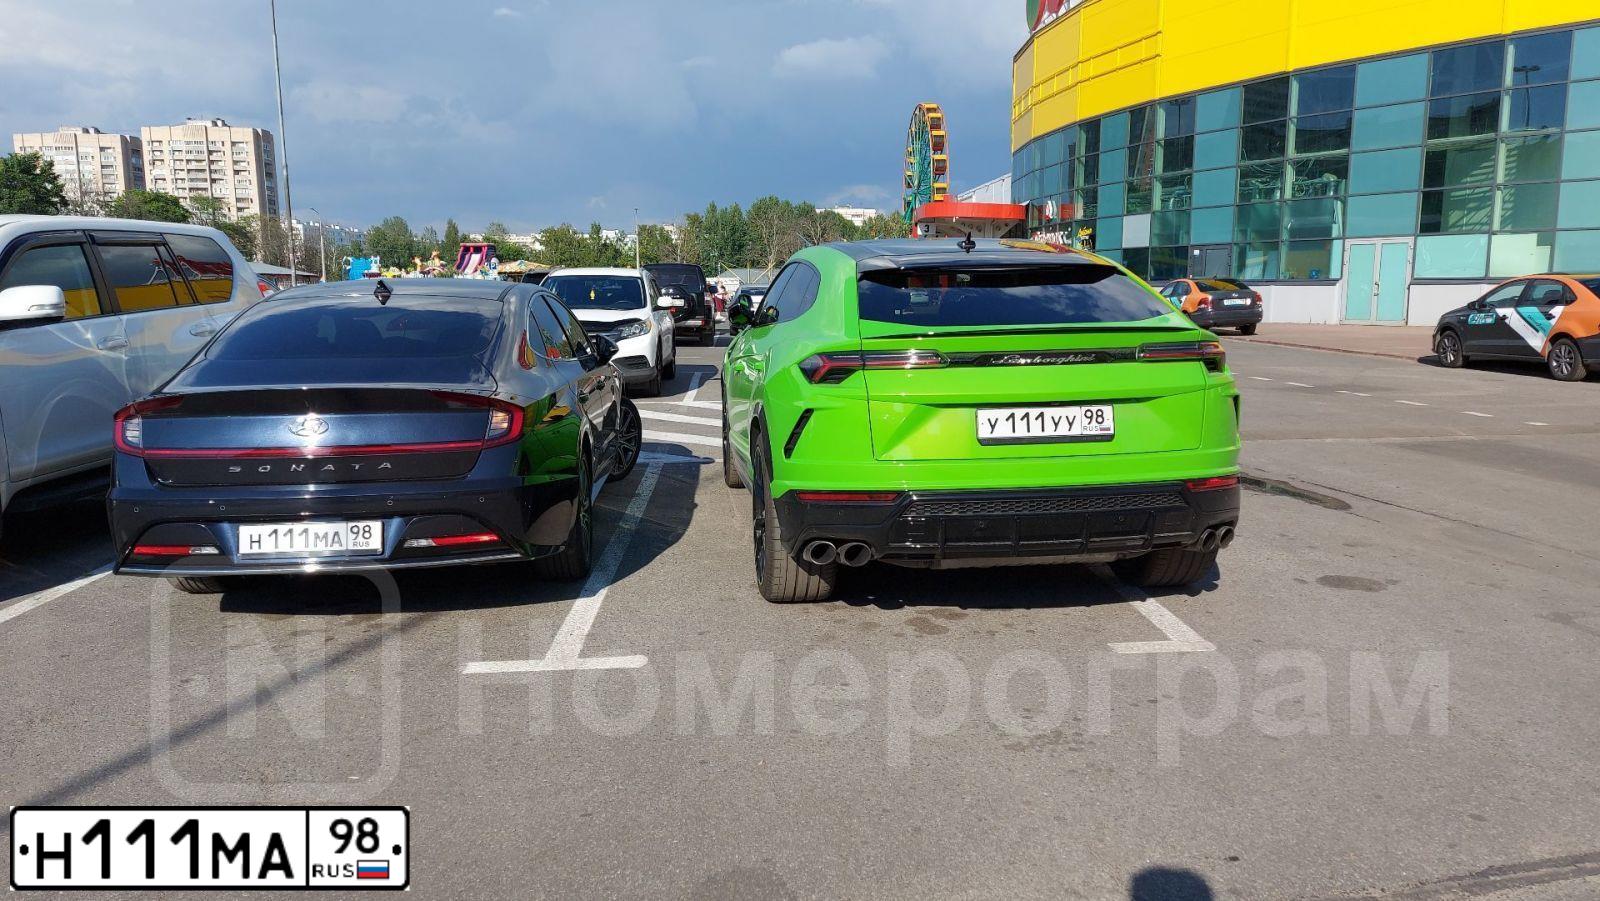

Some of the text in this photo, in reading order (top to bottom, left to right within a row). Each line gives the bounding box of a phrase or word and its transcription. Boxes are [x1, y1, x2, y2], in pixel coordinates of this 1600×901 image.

[992, 353, 1097, 365] Lamborghini
[1083, 408, 1105, 425] 98
[228, 462, 393, 473] SONATA
[350, 524, 372, 541] 98
